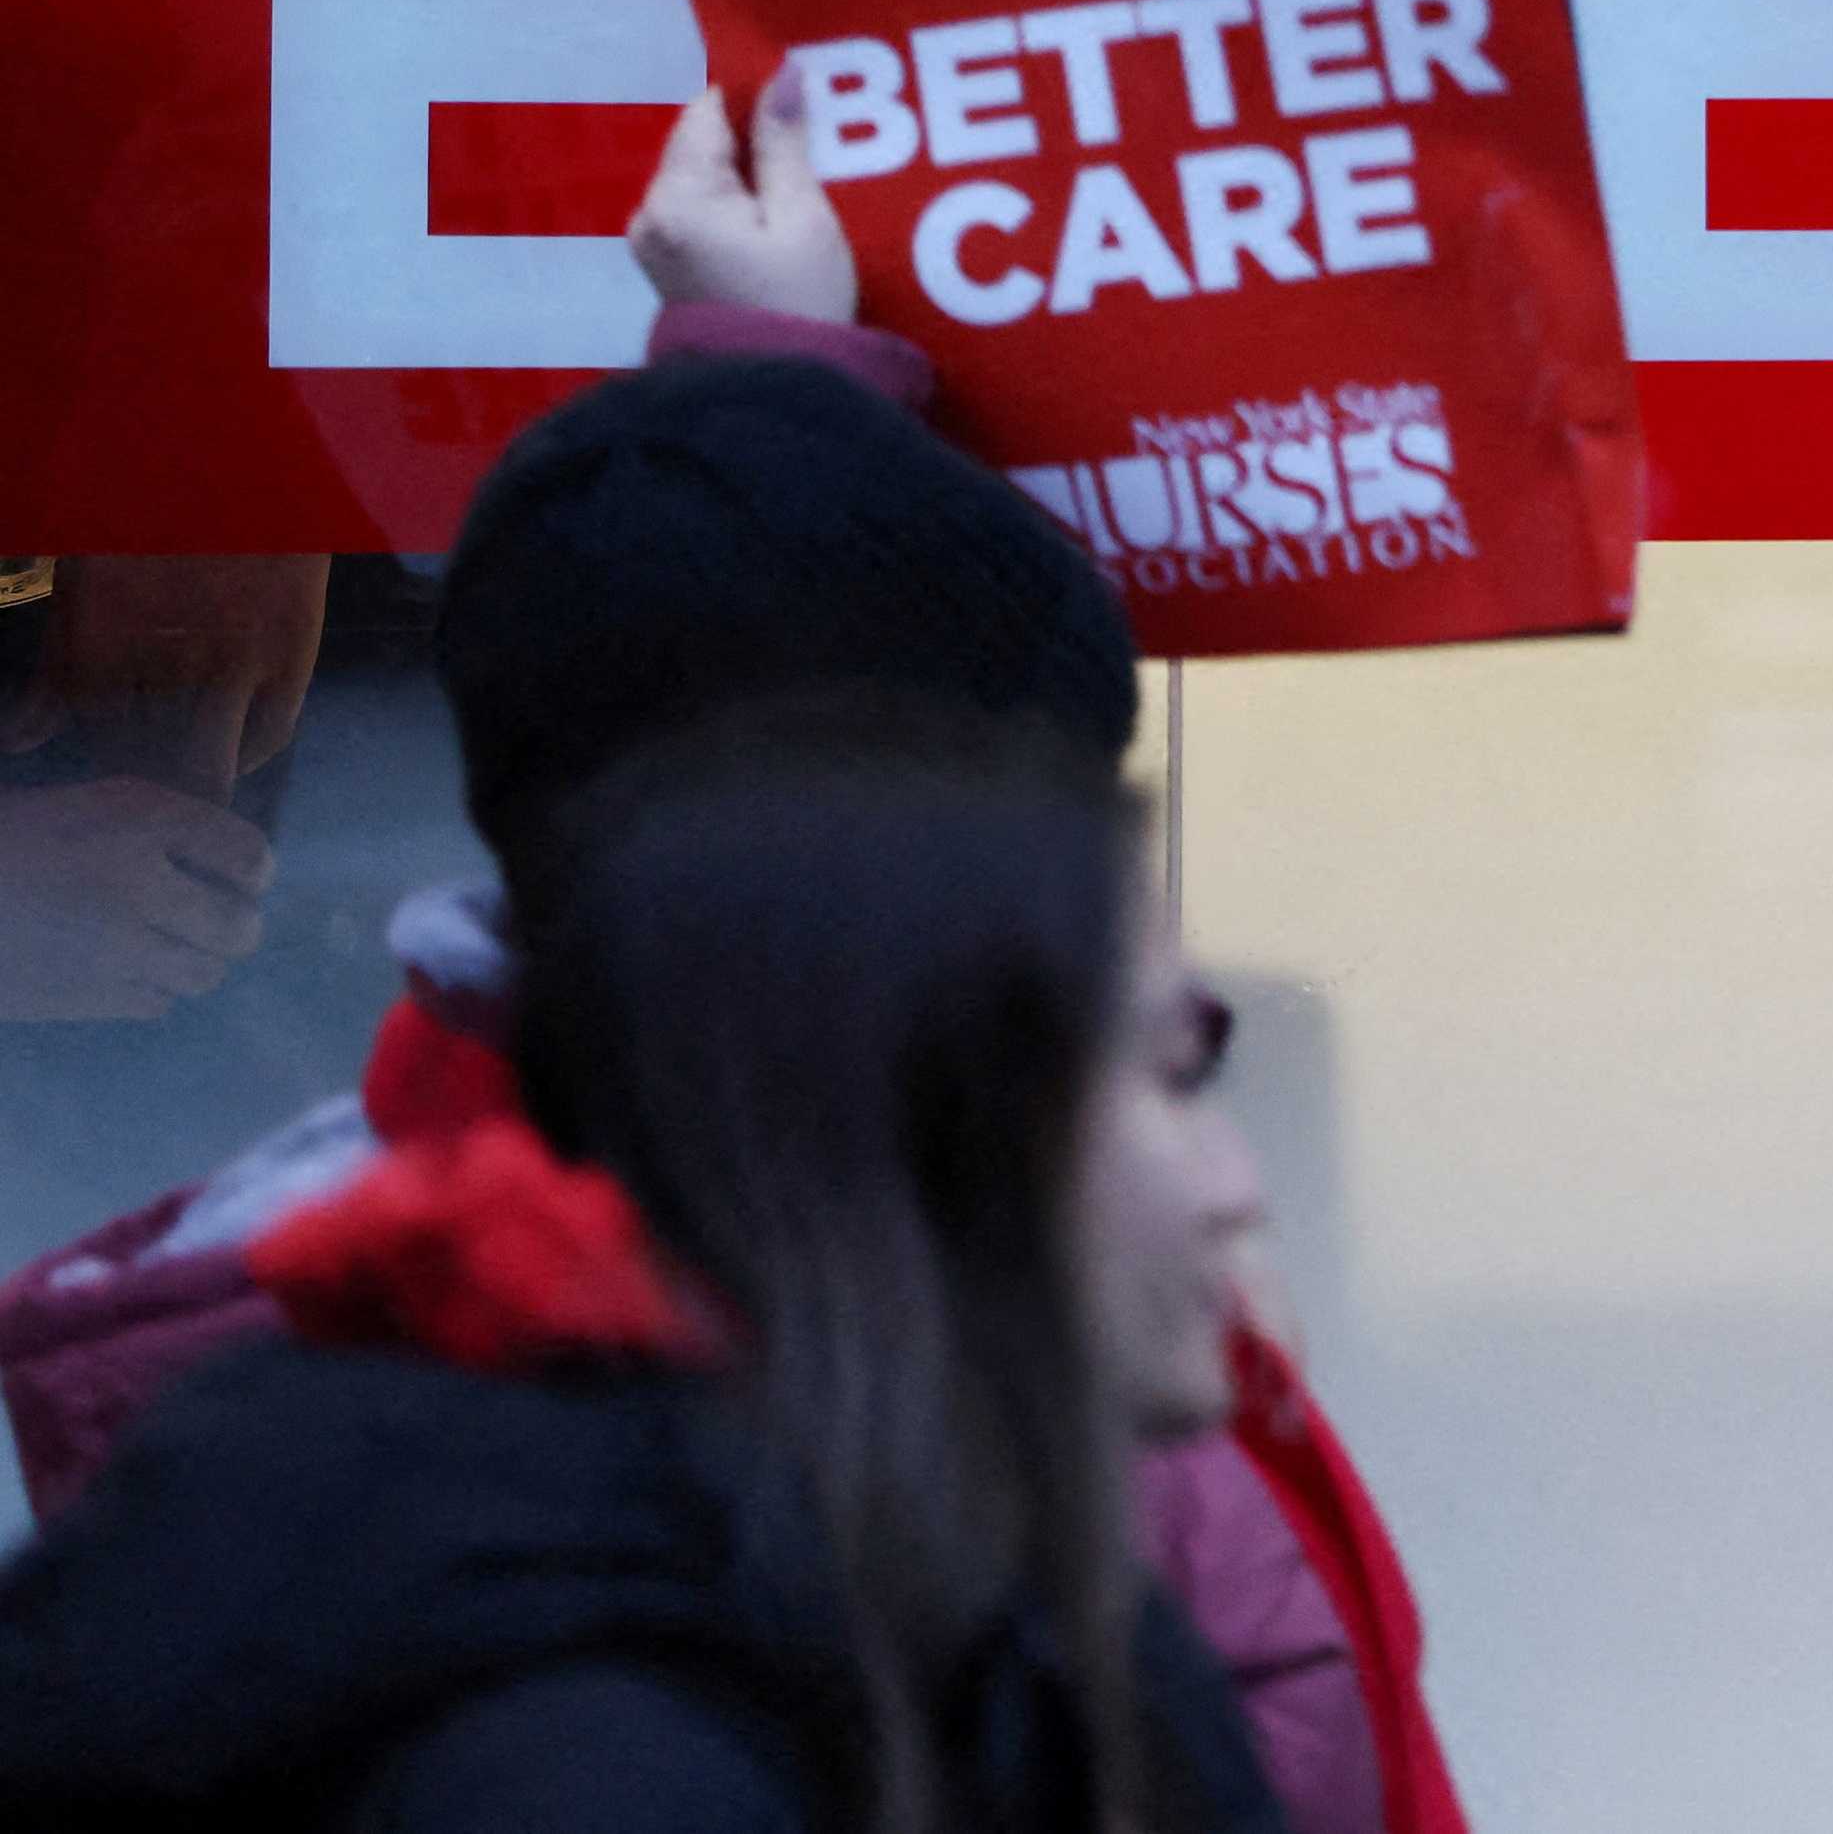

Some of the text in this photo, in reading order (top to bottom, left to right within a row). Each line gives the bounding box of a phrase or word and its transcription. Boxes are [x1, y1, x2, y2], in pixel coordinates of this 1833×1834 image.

[911, 125, 1432, 326] CARE
[1131, 380, 1442, 457] New York State
